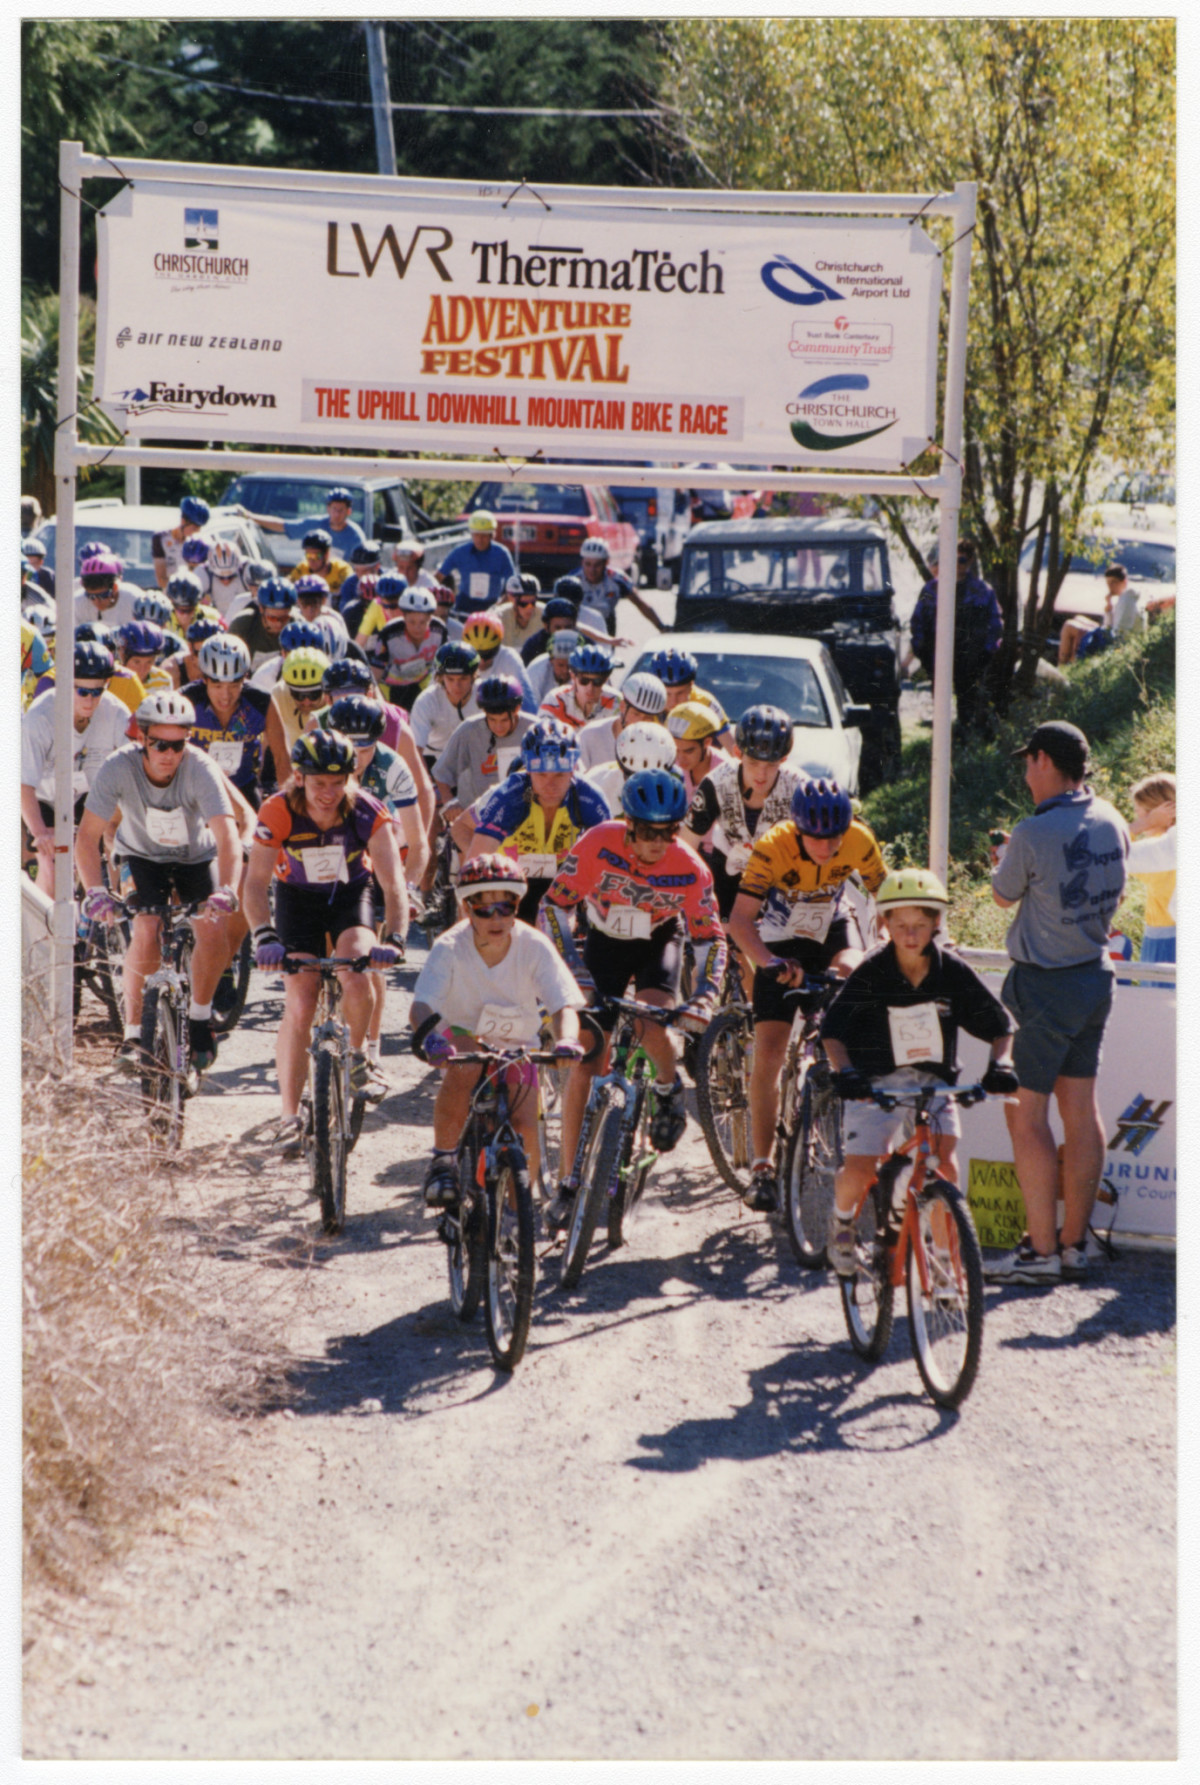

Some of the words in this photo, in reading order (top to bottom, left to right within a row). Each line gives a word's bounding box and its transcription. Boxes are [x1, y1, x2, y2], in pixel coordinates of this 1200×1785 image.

[327, 221, 453, 282] LWR
[154, 253, 248, 276] CHRISTCHURCH
[815, 260, 884, 273] Christchurch
[836, 275, 903, 286] International
[851, 288, 888, 299] Airport
[892, 288, 911, 298] Ltd
[421, 294, 632, 345] ADVENTURE
[843, 333, 880, 341] Canterbury
[788, 340, 861, 357] Community
[861, 342, 894, 355] Trust
[420, 334, 630, 384] FESTIVAL
[149, 381, 277, 410] Fairydown
[832, 394, 850, 402] THE
[315, 388, 350, 418] THE
[357, 389, 420, 422] UPHILL
[427, 393, 521, 426] DOWNHILL
[527, 397, 625, 430] MOUNTAIN
[631, 402, 673, 432] BIKE
[679, 404, 728, 435] RACE
[785, 403, 896, 419] CHRISTCHURCH
[813, 418, 842, 427] TOWN
[846, 420, 871, 429] HALL
[191, 727, 238, 742] TREK
[611, 915, 635, 937] 41
[792, 911, 824, 932] 25
[483, 1020, 513, 1038] 29
[970, 1164, 1021, 1188] WARN
[1104, 1163, 1176, 1181] URUN
[1137, 1186, 1176, 1199] Coun
